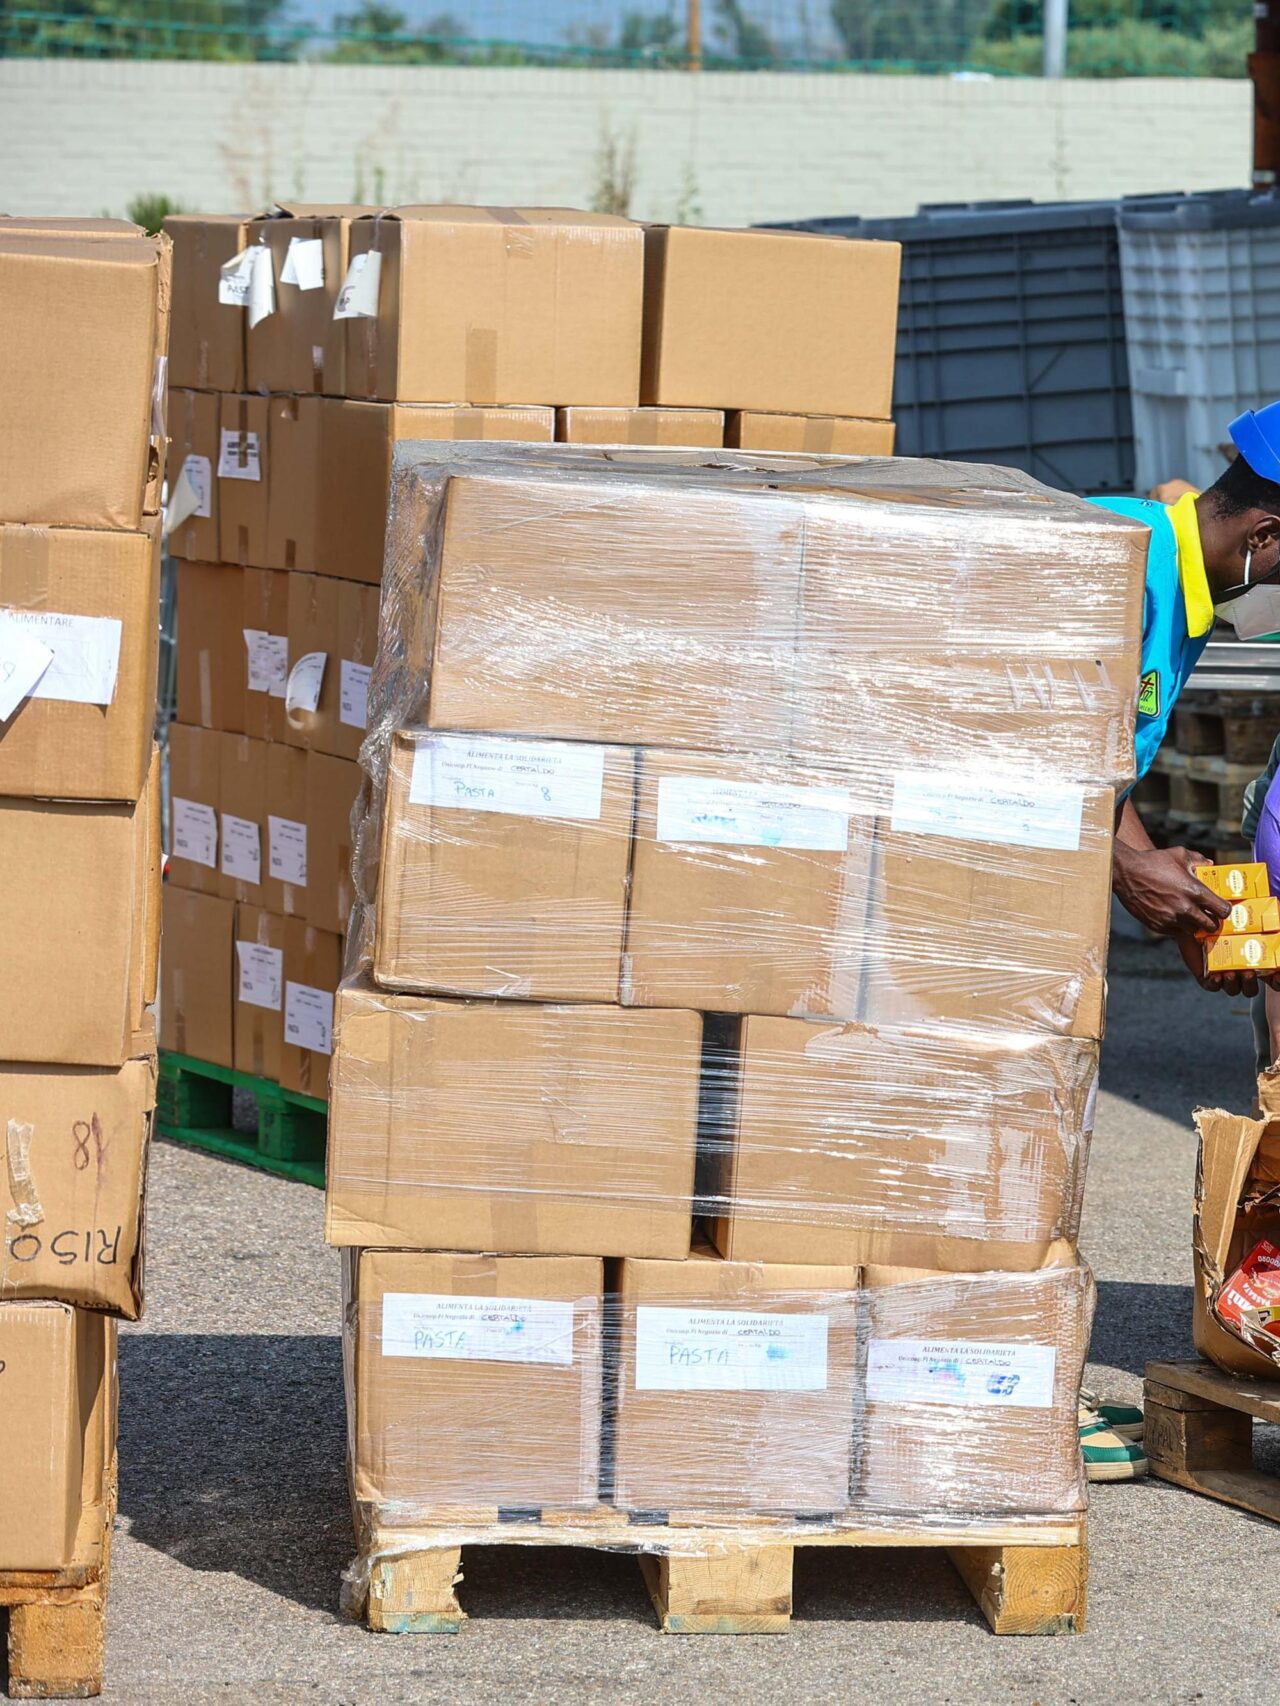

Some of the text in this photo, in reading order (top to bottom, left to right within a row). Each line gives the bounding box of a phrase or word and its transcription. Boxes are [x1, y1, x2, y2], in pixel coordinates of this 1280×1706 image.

[453, 780, 495, 798] PASTA
[10, 1226, 121, 1265] RISO
[1241, 1283, 1271, 1306] PASSATA
[414, 1330, 466, 1350] PASTA
[670, 1345, 729, 1366] PASTA
